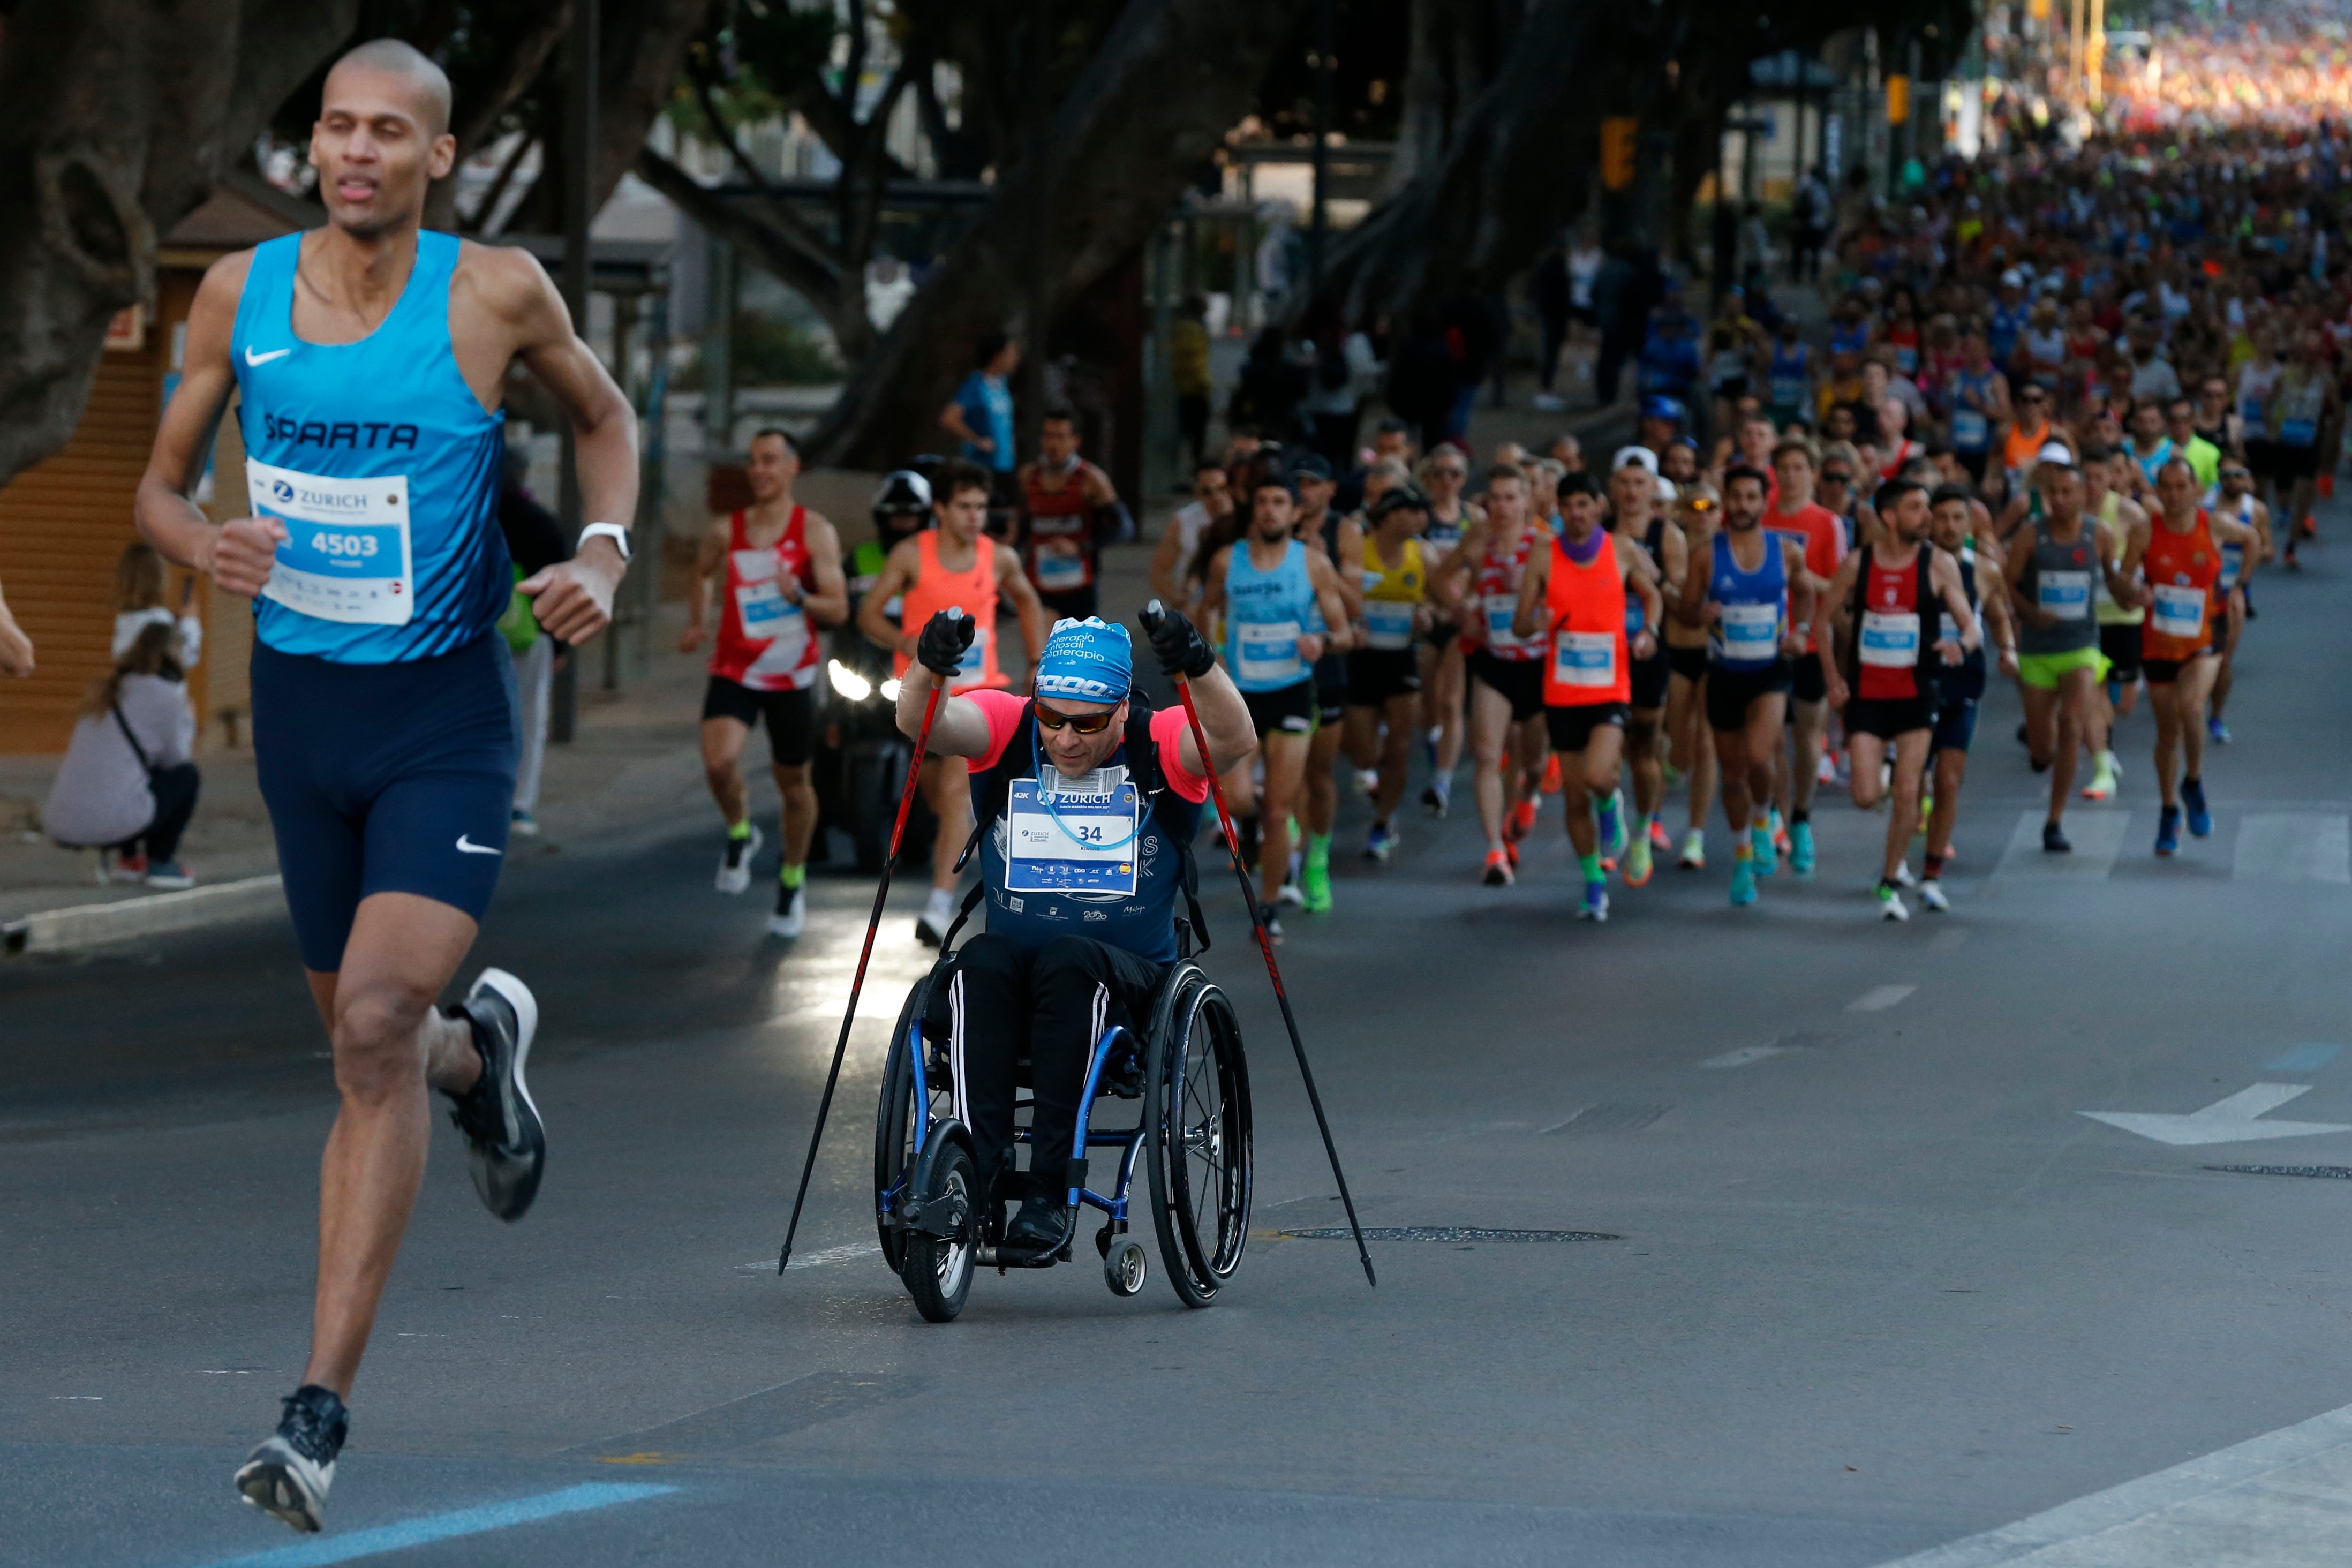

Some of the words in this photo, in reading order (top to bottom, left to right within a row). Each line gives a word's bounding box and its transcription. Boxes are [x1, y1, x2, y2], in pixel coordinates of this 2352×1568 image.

[265, 413, 419, 450] SPARTA
[301, 491, 367, 507] ZURICH
[312, 531, 379, 557] 4503
[1060, 794, 1111, 804] ZURICH
[1078, 826, 1102, 841] 34
[1083, 910, 1107, 920] 2020
